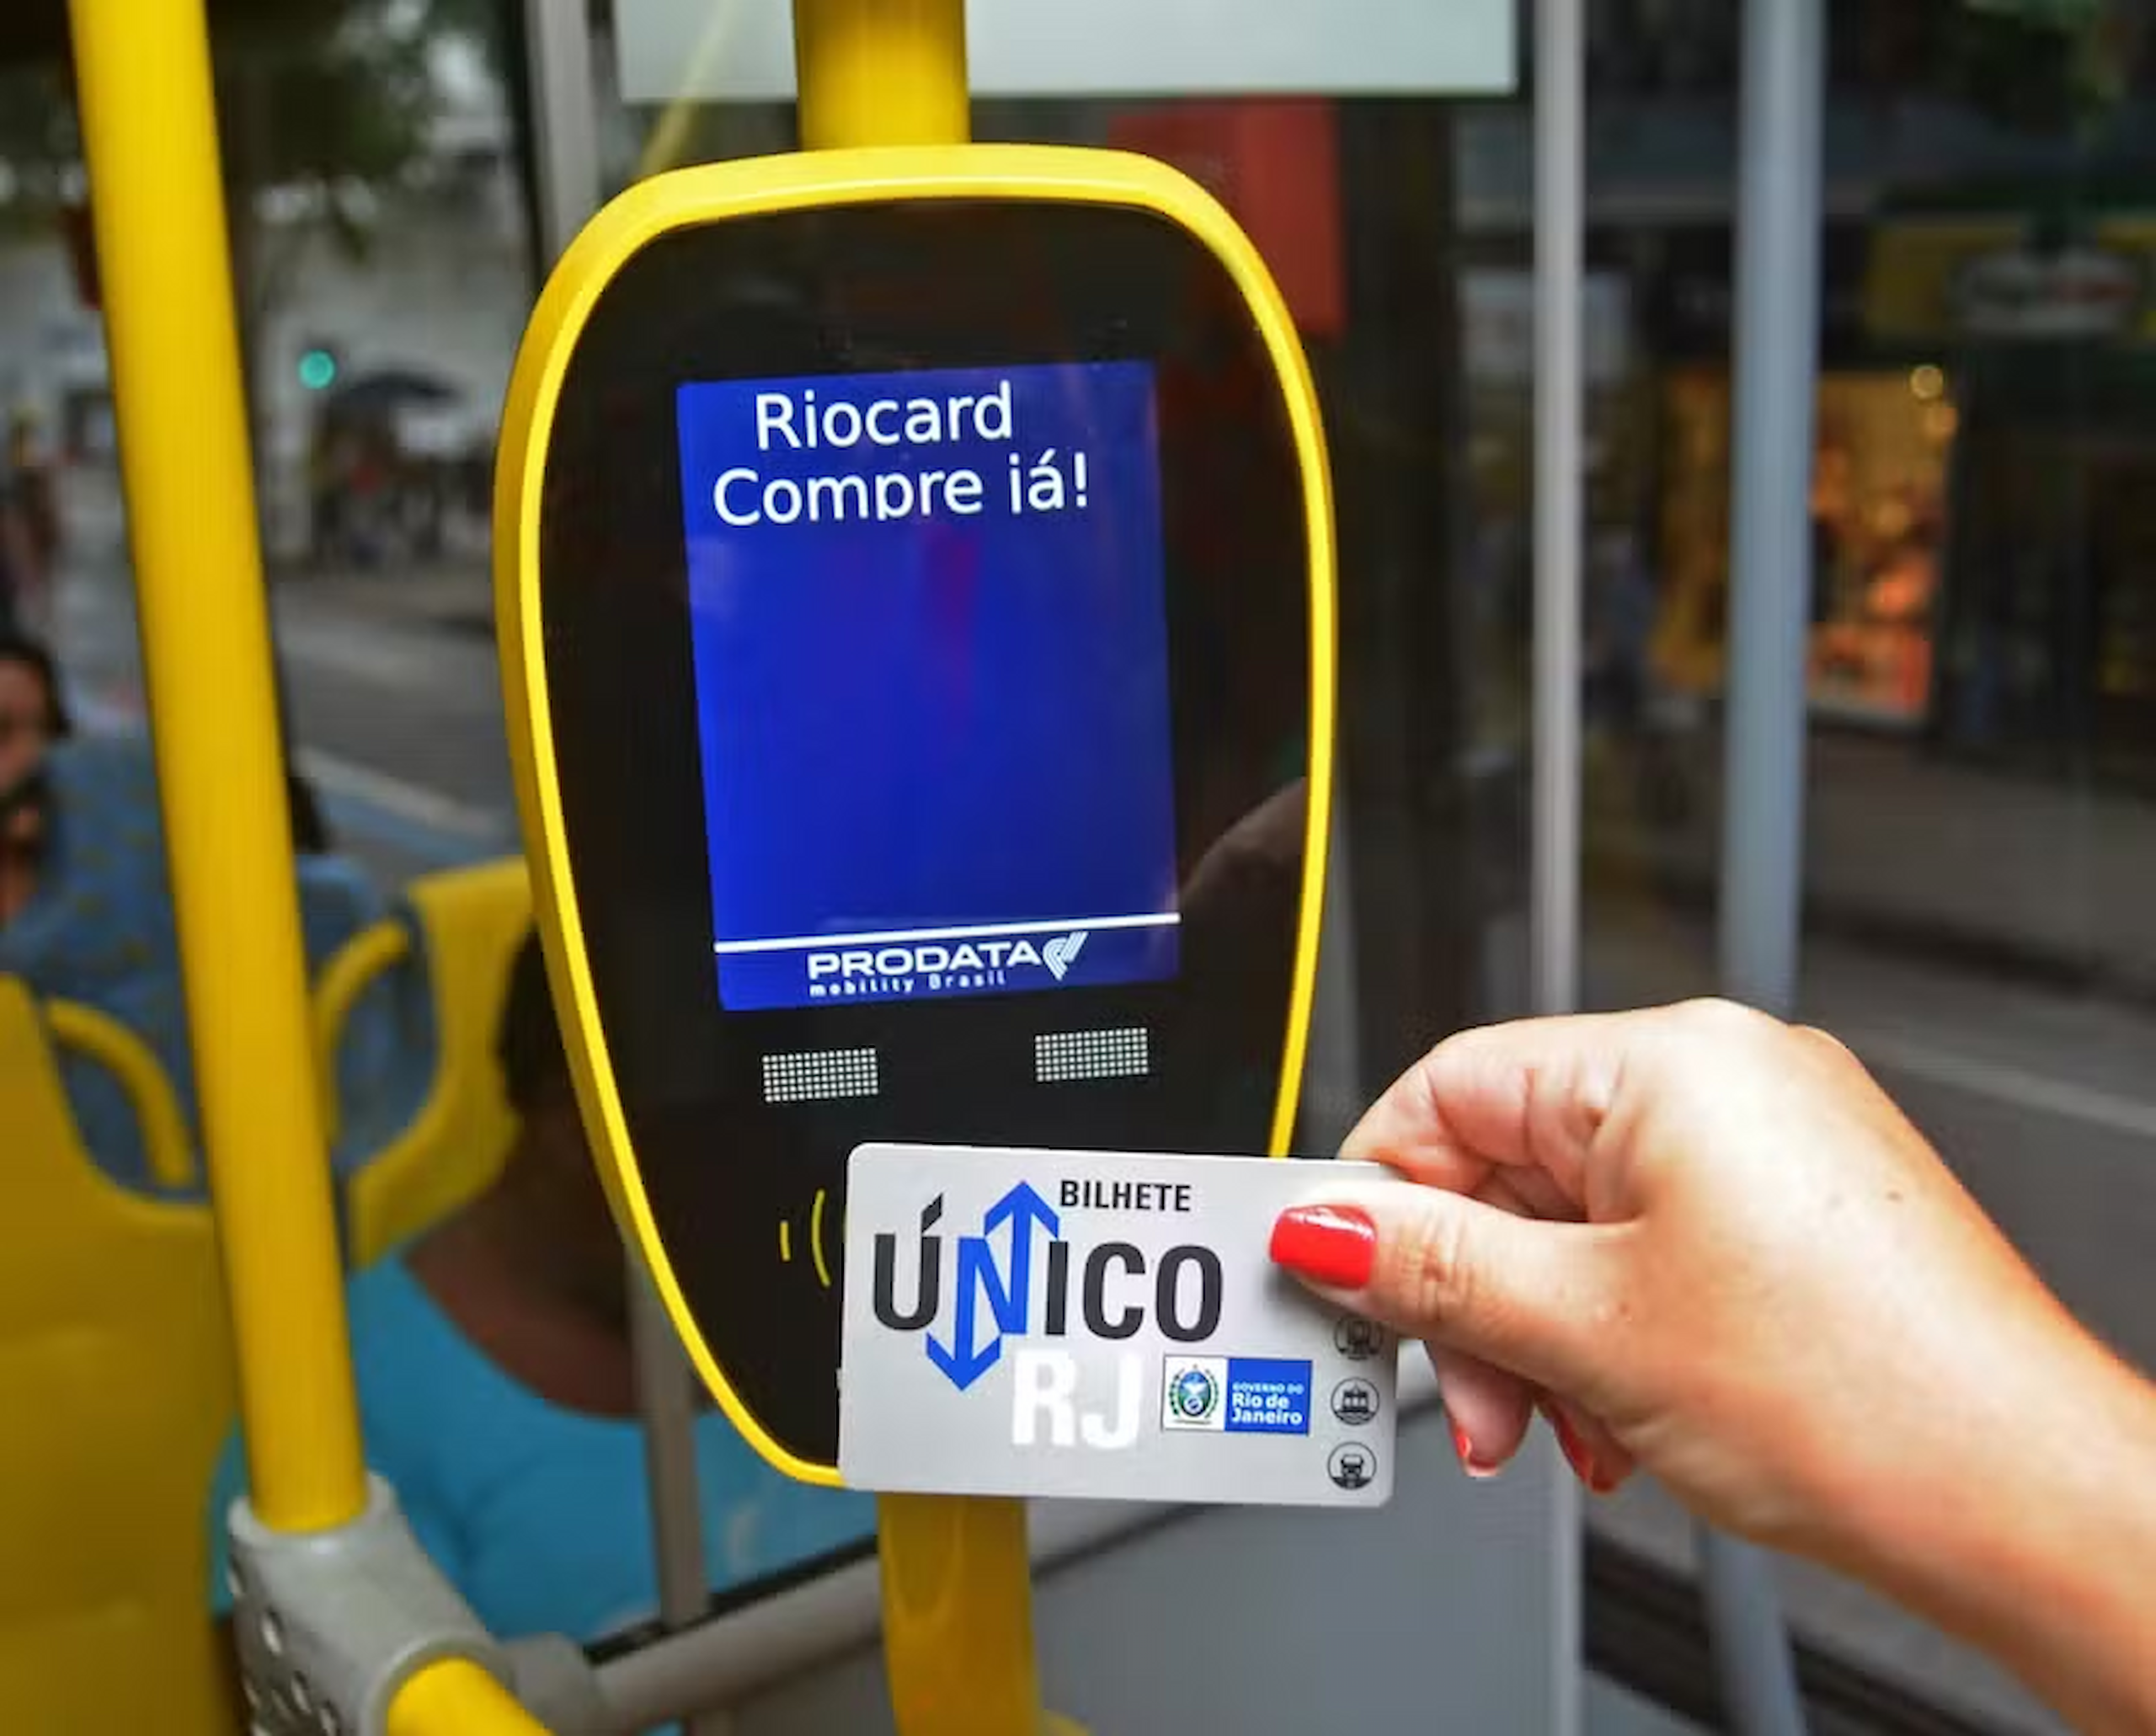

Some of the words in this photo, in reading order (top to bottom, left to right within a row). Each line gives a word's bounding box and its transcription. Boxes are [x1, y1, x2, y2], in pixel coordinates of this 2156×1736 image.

[755, 380, 1012, 451] Riocard
[712, 467, 984, 526] Compre
[807, 941, 1043, 980] PRODATA
[809, 978, 915, 997] mobility
[929, 970, 1006, 991] Brasil
[1059, 1180, 1192, 1212] BILHETE
[873, 1183, 1224, 1369] ÚNICO
[1012, 1349, 1144, 1450] RJ
[1231, 1407, 1304, 1425] Janeiro
[1232, 1392, 1263, 1409] Rio
[1265, 1394, 1290, 1410] de
